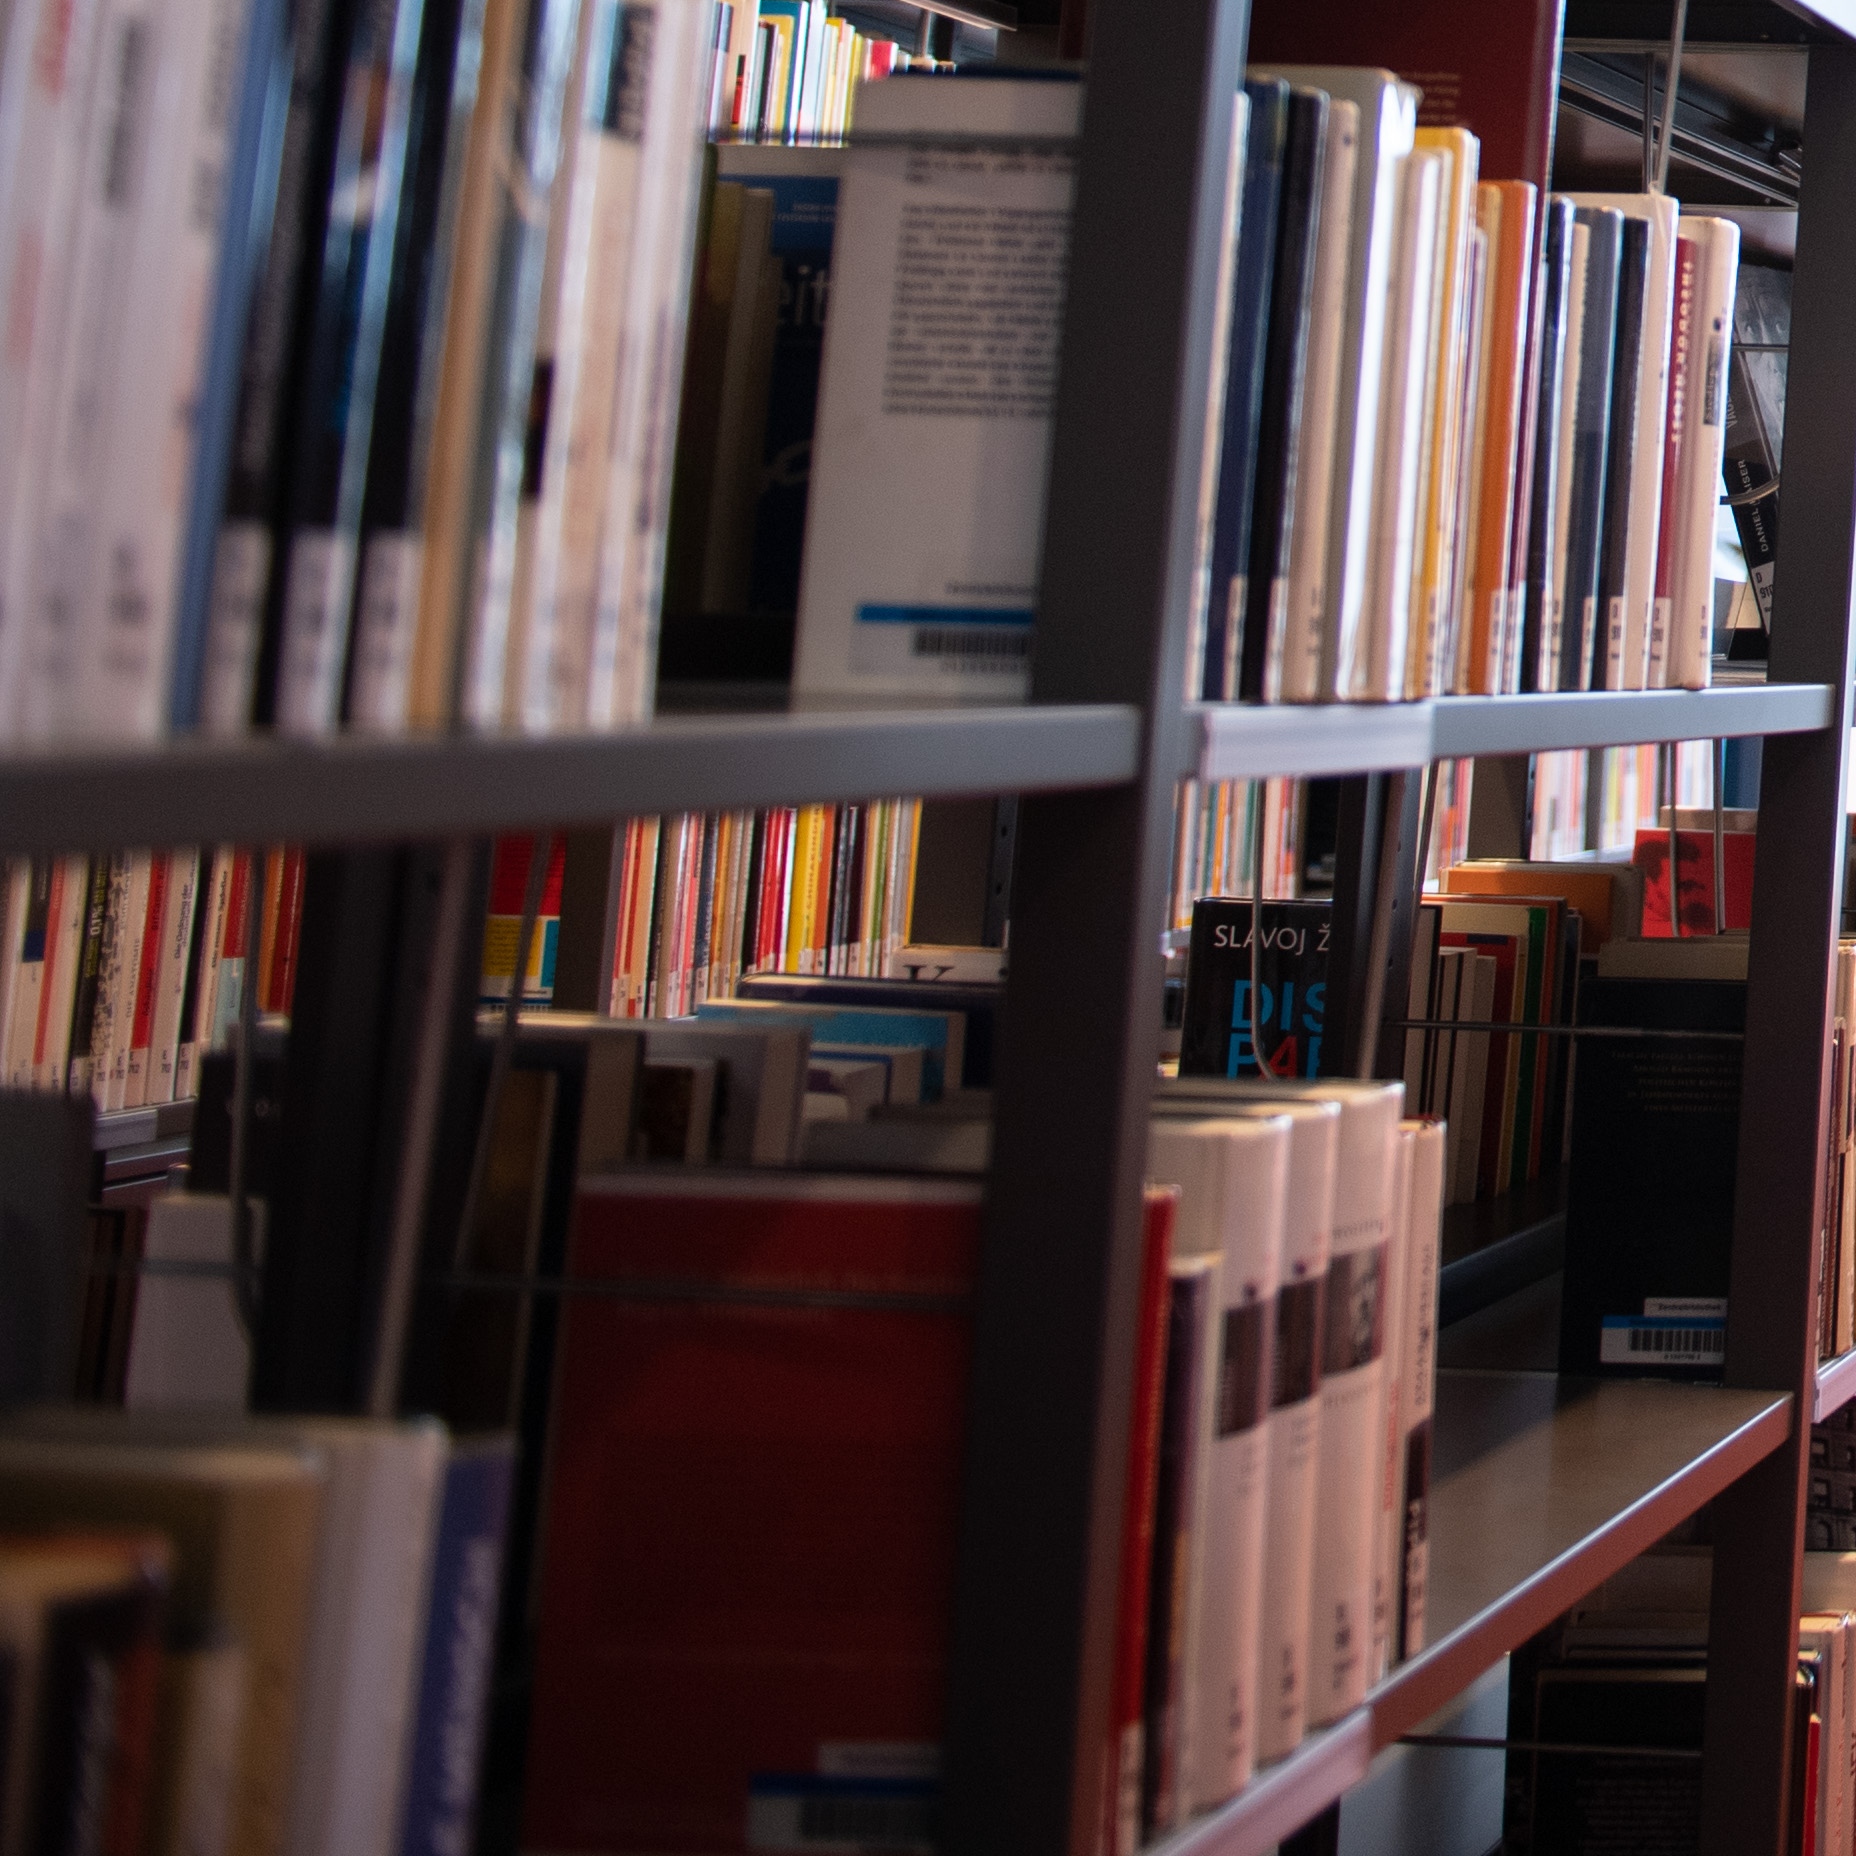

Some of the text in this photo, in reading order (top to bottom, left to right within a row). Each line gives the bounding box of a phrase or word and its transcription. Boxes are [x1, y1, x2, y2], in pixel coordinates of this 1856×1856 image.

[1737, 458, 1770, 553] DANIEL AISER
[1213, 923, 1331, 956] SLAVOJ Ž
